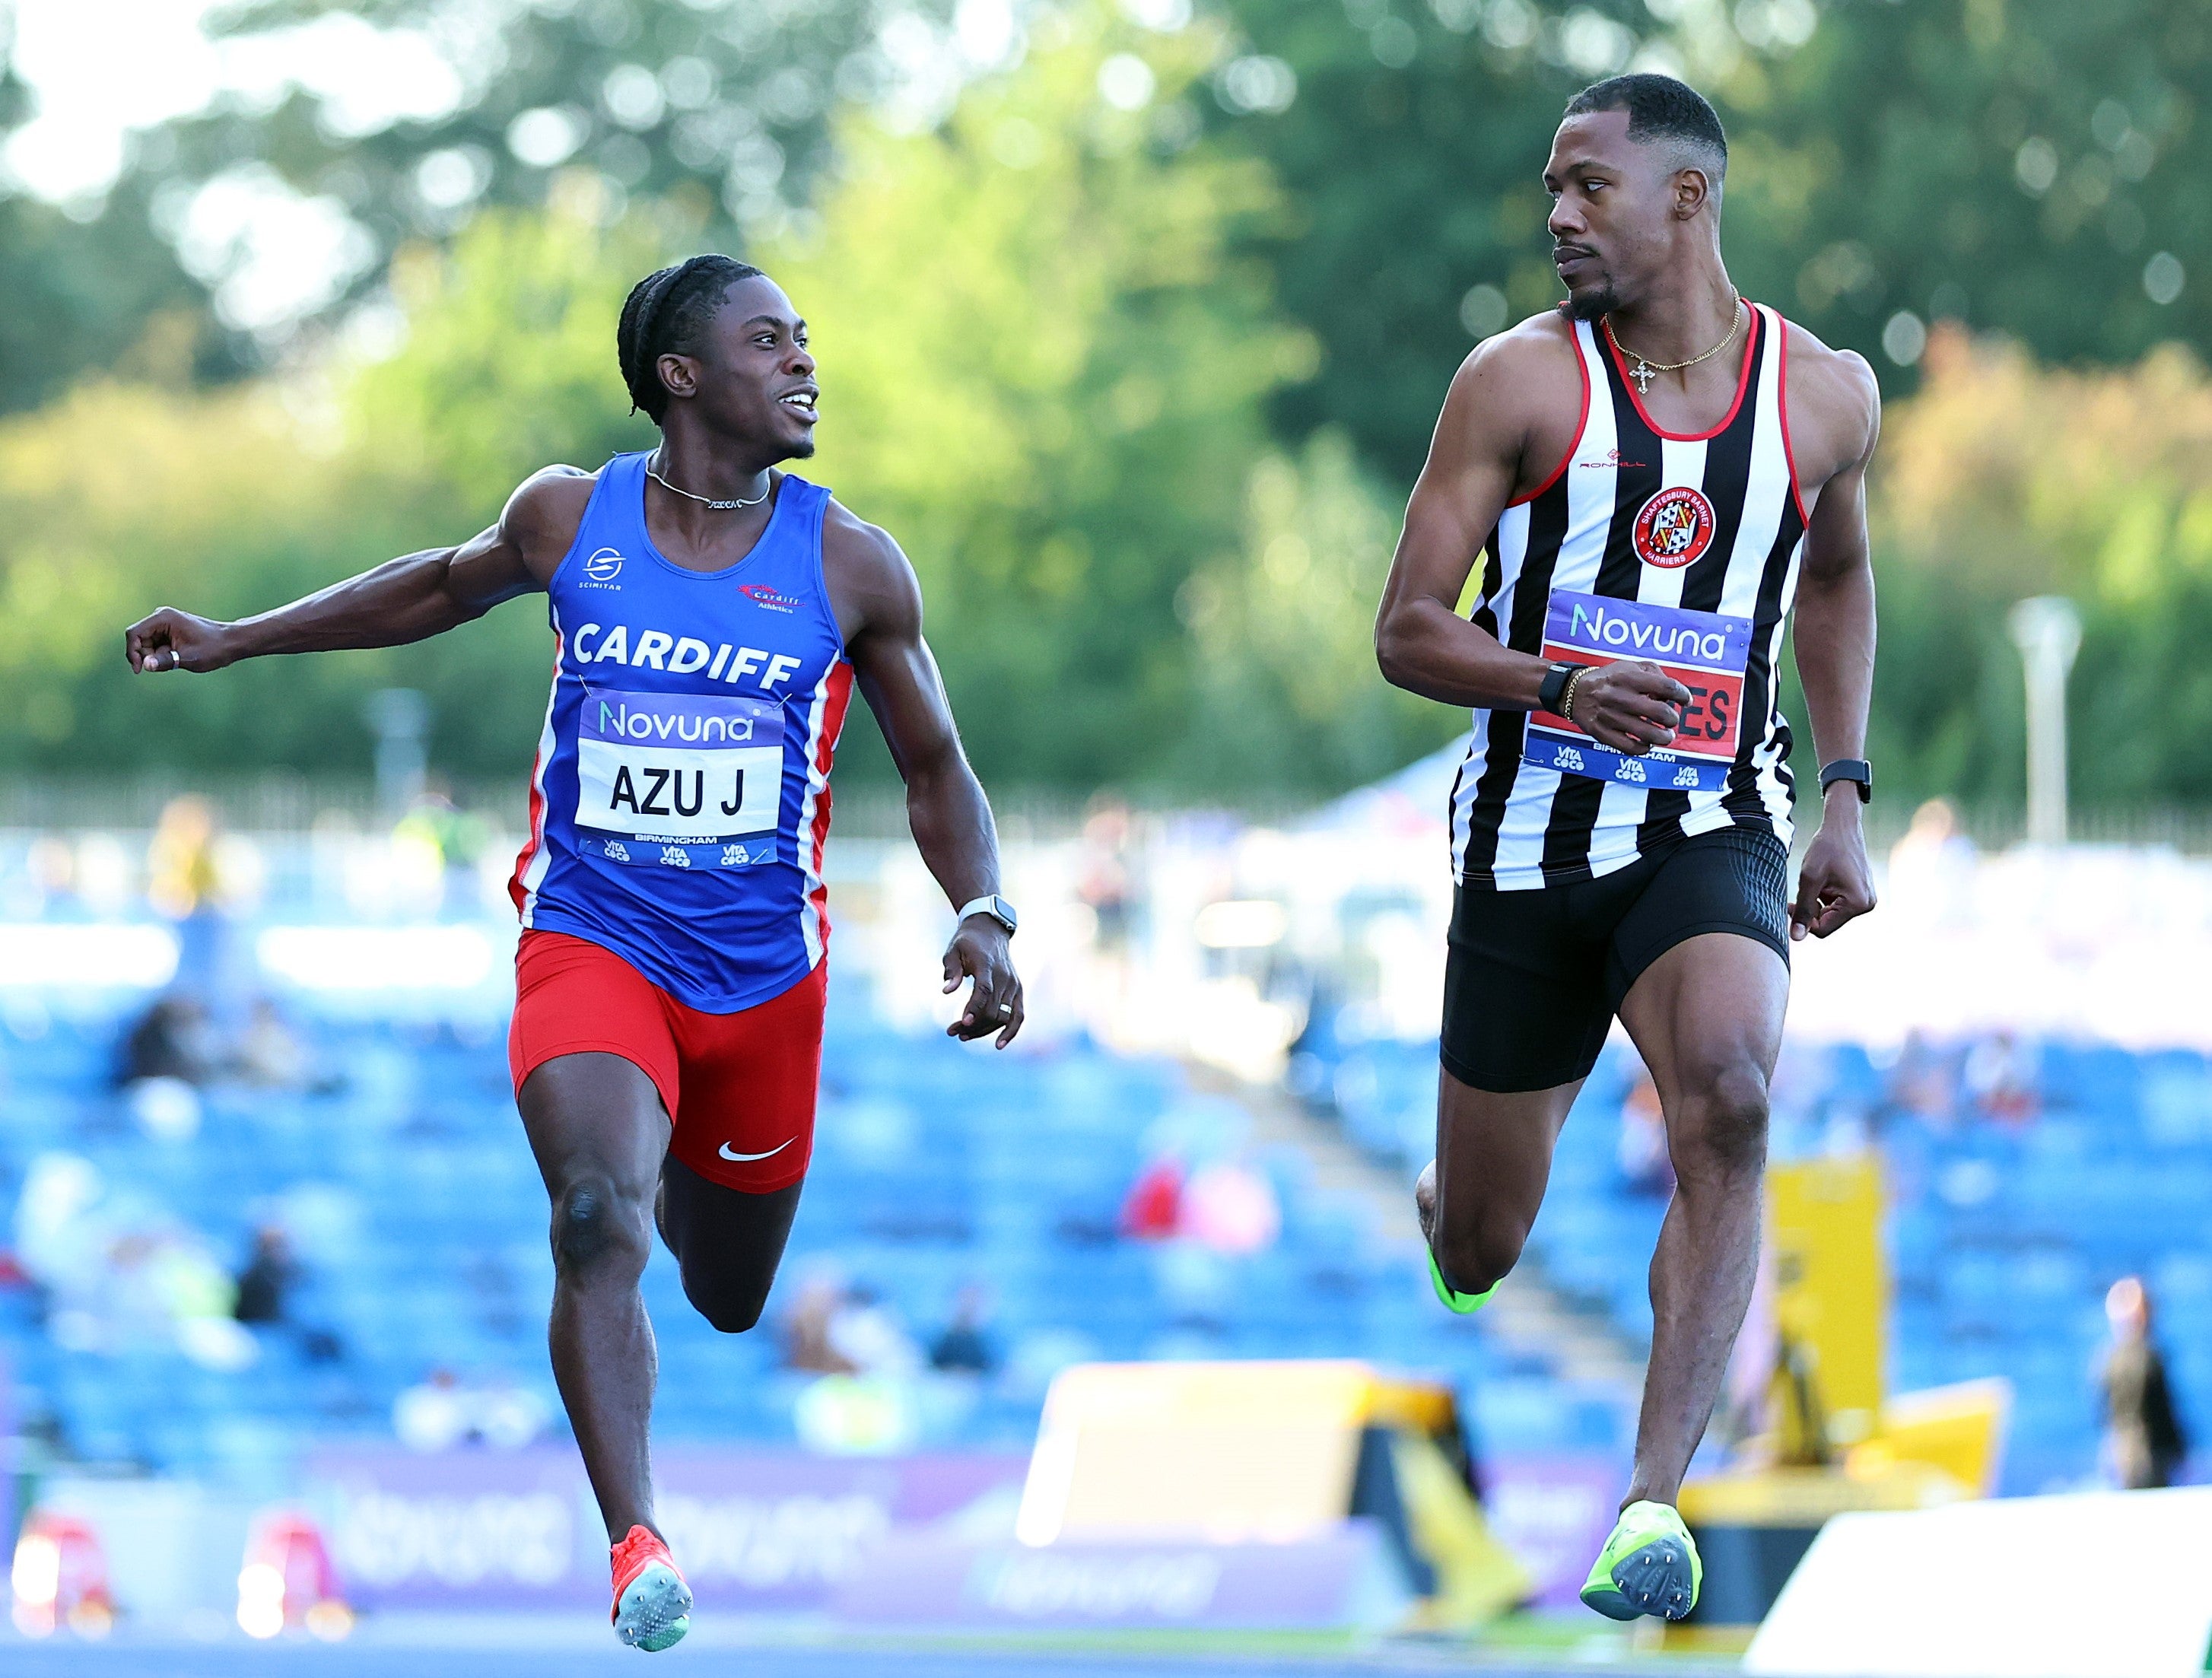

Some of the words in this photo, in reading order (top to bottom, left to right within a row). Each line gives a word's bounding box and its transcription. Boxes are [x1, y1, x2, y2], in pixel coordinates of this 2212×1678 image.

[1641, 491, 1692, 525] SHAFTESBURY
[1690, 493, 1710, 528] BARNET
[1645, 550, 1686, 565] HARRIERS
[578, 581, 621, 591] SCIMITAR
[754, 591, 799, 605] Cardiff
[758, 602, 794, 614] Athletics
[1570, 603, 1725, 661] Novuna
[574, 622, 802, 690] CARDIFF
[599, 701, 754, 742] Novuna
[1558, 745, 1582, 761] VITA
[1553, 757, 1584, 771] COCO
[1619, 758, 1645, 773] VITA
[1615, 769, 1647, 783] COCO
[1678, 766, 1699, 778] VITA
[1673, 773, 1700, 787] COCO
[609, 765, 704, 816] AZU
[720, 769, 744, 816] J
[634, 834, 717, 844] BIRMINGHAM
[605, 839, 627, 854] VITA
[662, 845, 688, 859] VITA
[723, 843, 745, 857] VITA
[604, 848, 631, 862] COCO
[659, 853, 691, 868] COCO
[720, 853, 750, 866] COCO
